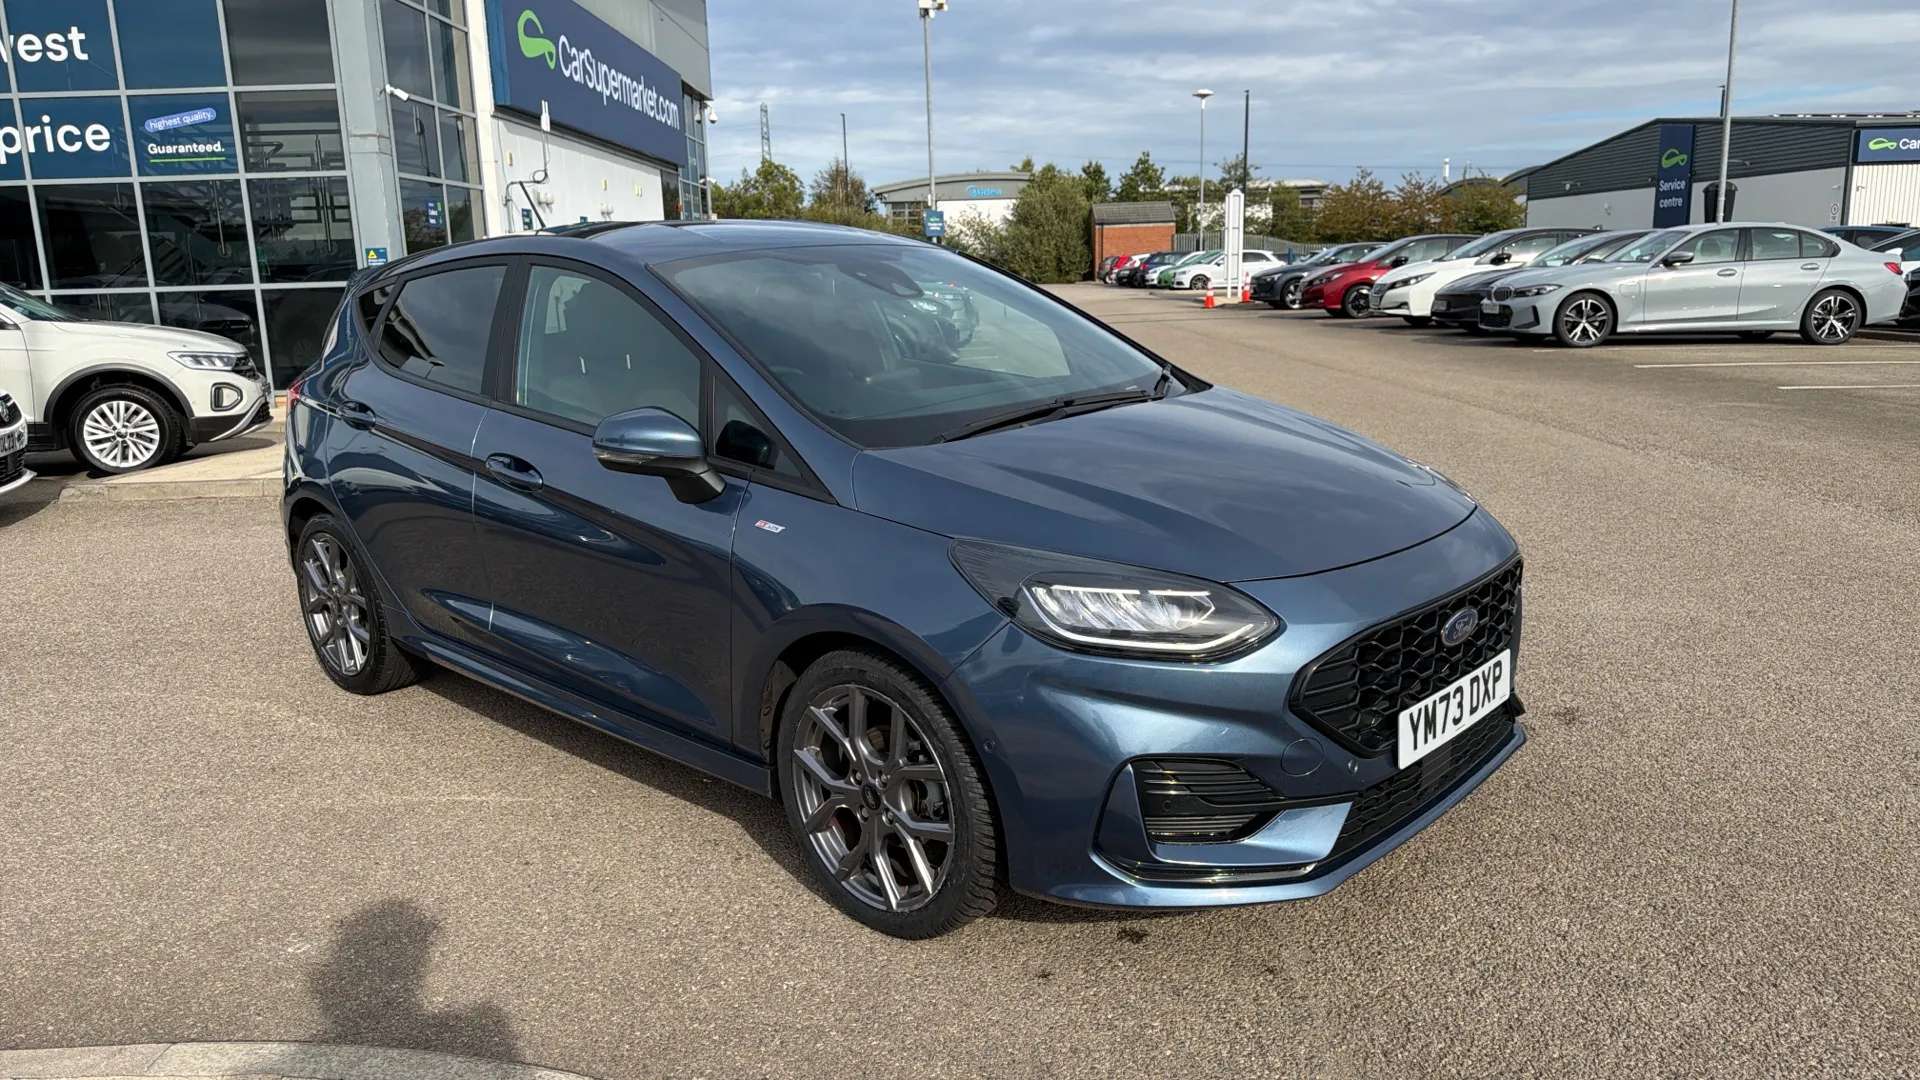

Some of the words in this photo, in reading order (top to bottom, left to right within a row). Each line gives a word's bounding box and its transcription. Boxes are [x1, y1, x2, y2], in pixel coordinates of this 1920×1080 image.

[558, 34, 680, 130] CarSupermarket.com
[149, 117, 180, 131] highest
[0, 114, 111, 165] price
[147, 140, 225, 154] Guaranteed.
[1659, 178, 1686, 191] Service
[1659, 197, 1683, 208] centre
[1409, 685, 1464, 751] YM73
[1469, 660, 1503, 716] DXP
